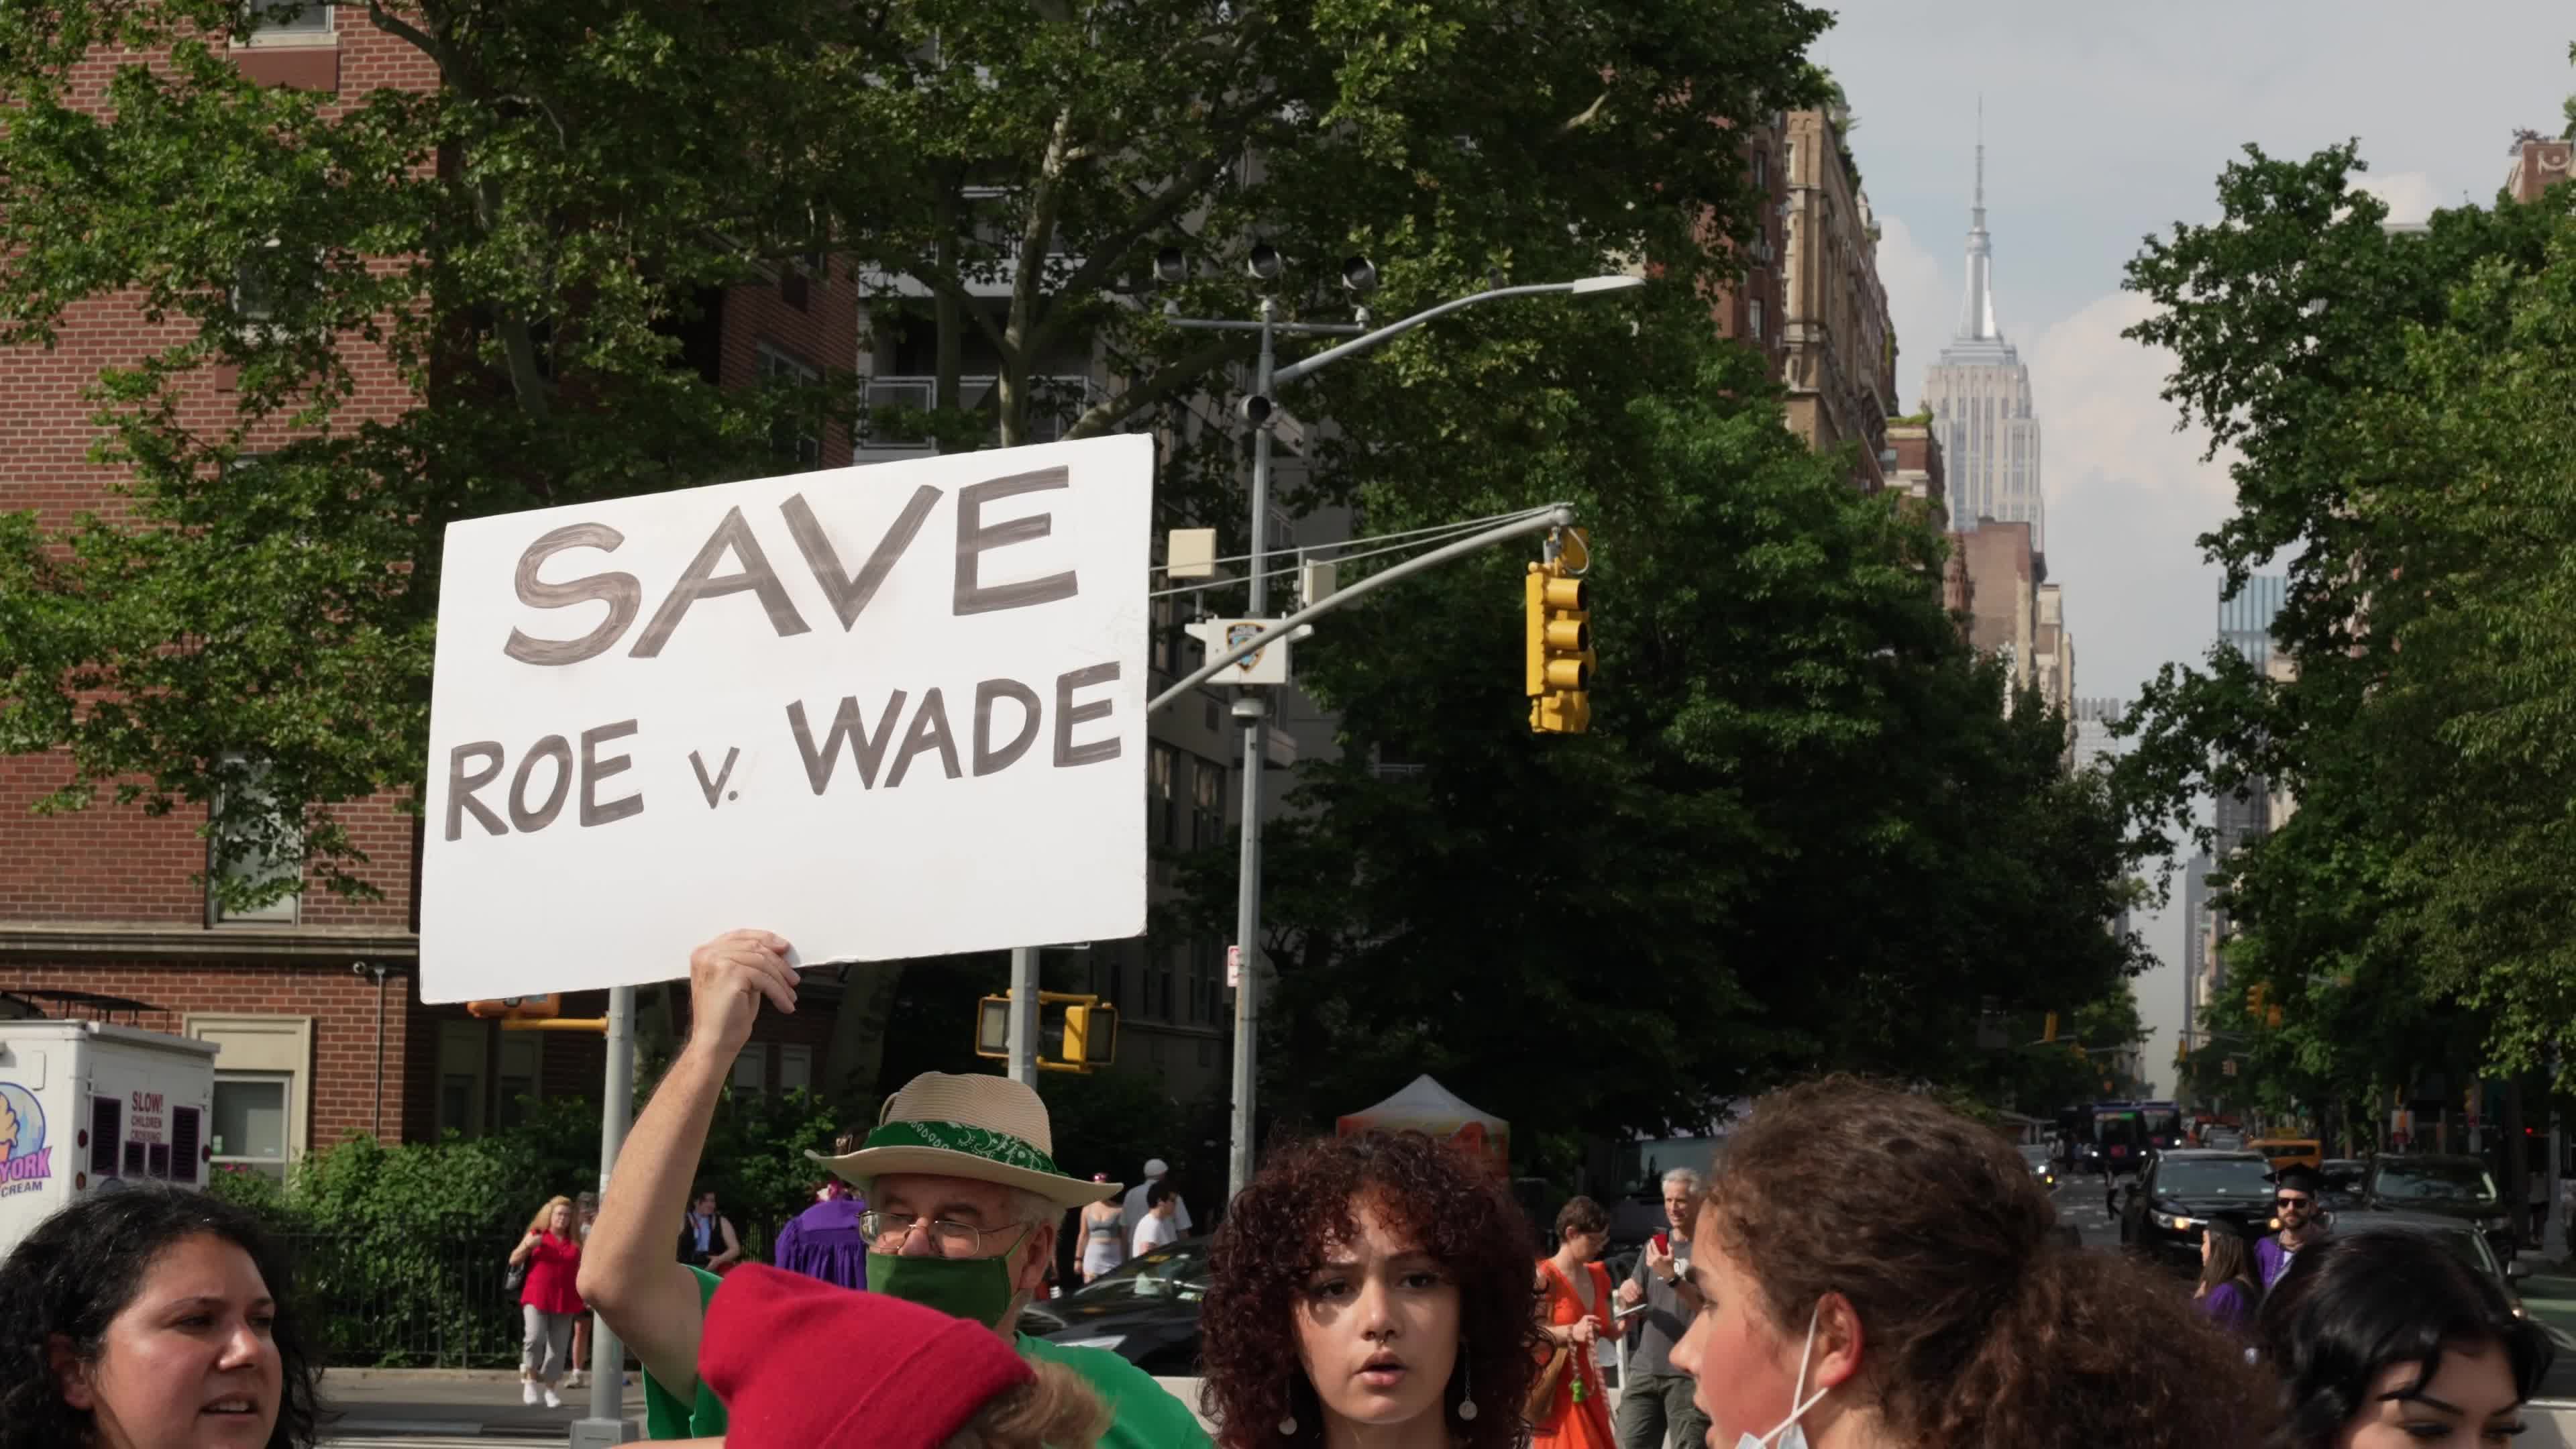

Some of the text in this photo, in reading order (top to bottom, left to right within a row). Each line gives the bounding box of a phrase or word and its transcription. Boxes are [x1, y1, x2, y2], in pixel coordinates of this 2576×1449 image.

[503, 465, 1079, 666] SAVE
[445, 718, 644, 842] ROE
[786, 661, 1122, 796] WADE
[131, 1090, 163, 1113] SLOW!
[0, 1146, 52, 1183] YORK
[1, 1181, 42, 1197] CREAM
